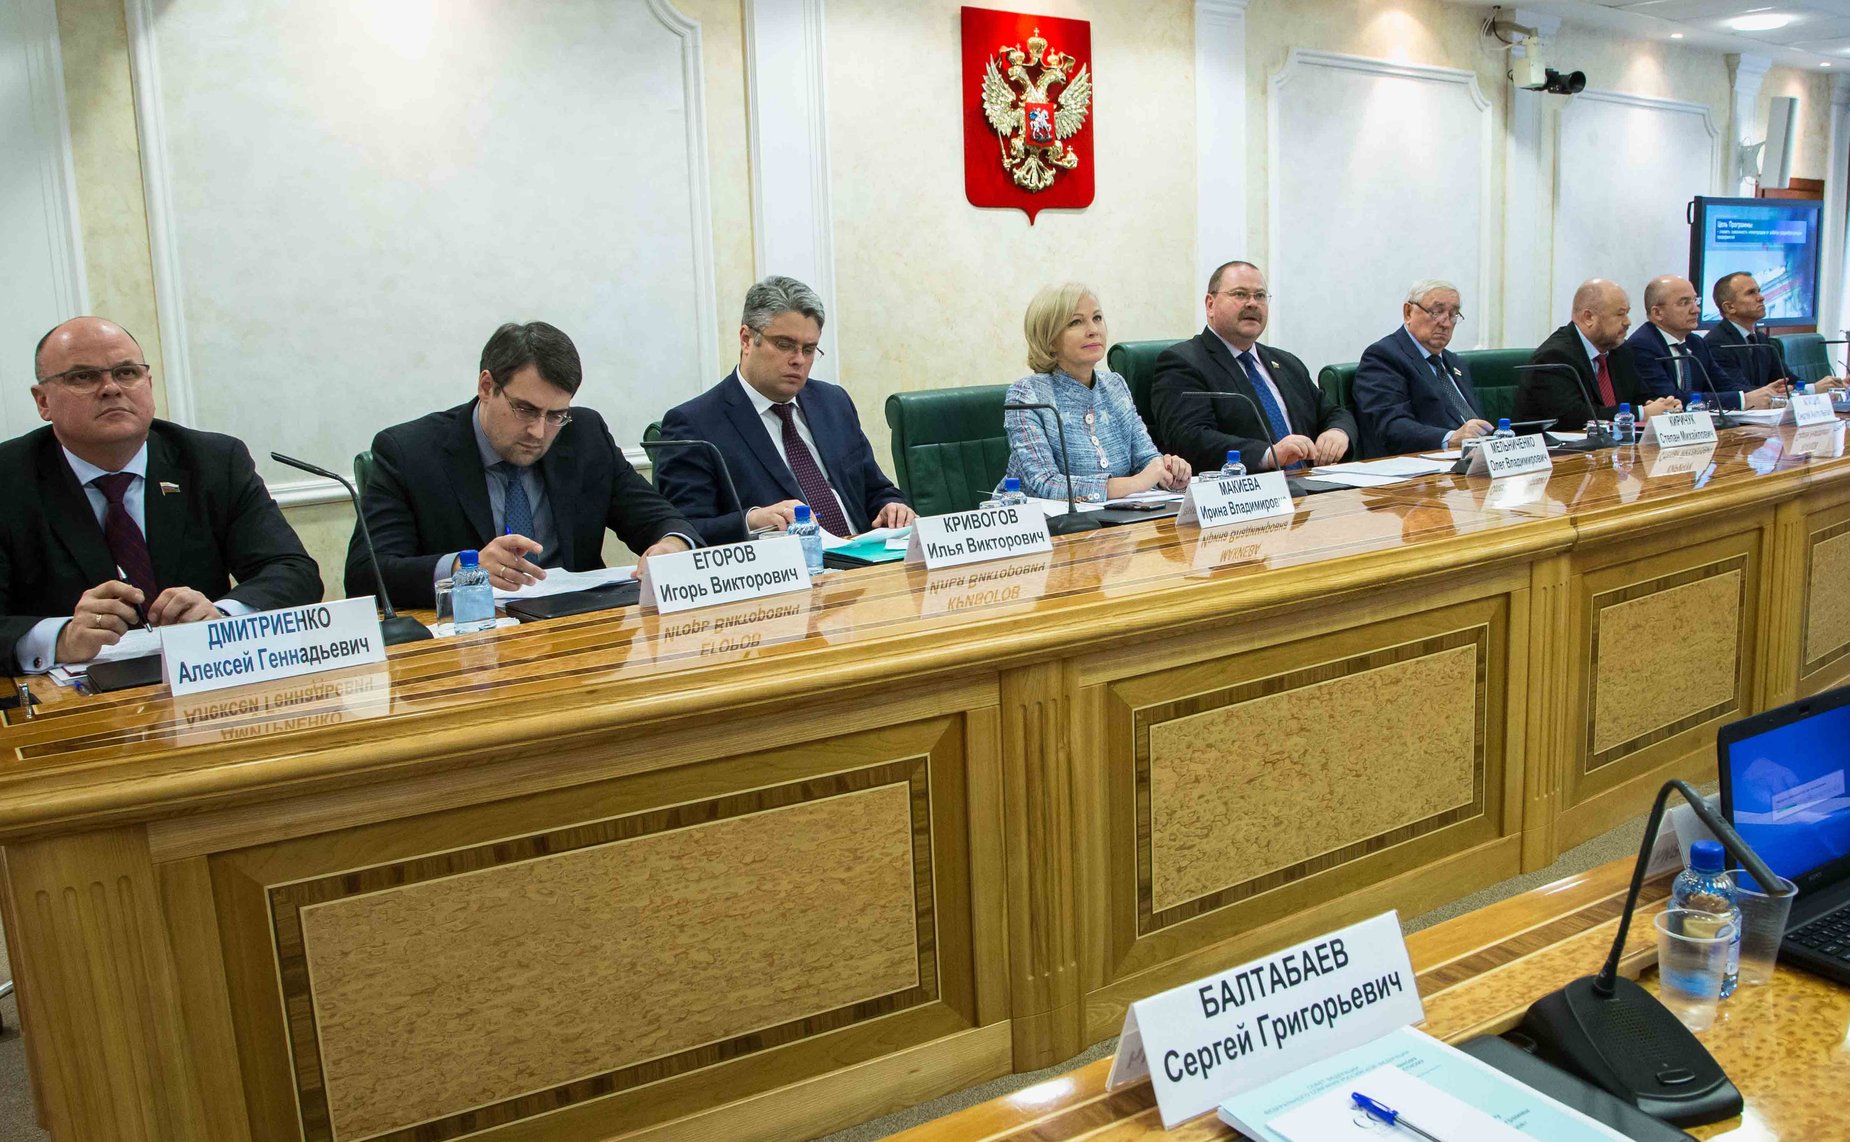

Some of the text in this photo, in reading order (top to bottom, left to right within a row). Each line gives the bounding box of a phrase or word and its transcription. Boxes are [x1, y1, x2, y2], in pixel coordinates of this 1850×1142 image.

[1490, 436, 1535, 454] МЕЛЬНИЧЕНКО
[1660, 432, 1680, 444] Степан
[1490, 453, 1547, 472] Олег Владимирович
[1218, 477, 1262, 496] МАКИЕВА
[943, 508, 1019, 533] КРИВОГОВ
[1200, 505, 1228, 522] Ирина
[1228, 496, 1287, 516] Владимиров
[693, 544, 757, 570] ЕГОРОВ
[927, 531, 1045, 560] Илья Викторович
[659, 567, 798, 604] Игорь Викторович
[207, 606, 331, 649] ДМИТРИЕНКО
[178, 637, 370, 683] Алексей Геннадьевич
[1199, 937, 1349, 1019] БАЛТАБАЕВ
[1164, 1022, 1254, 1083] Сергей
[1256, 971, 1403, 1049] Григорьевич
